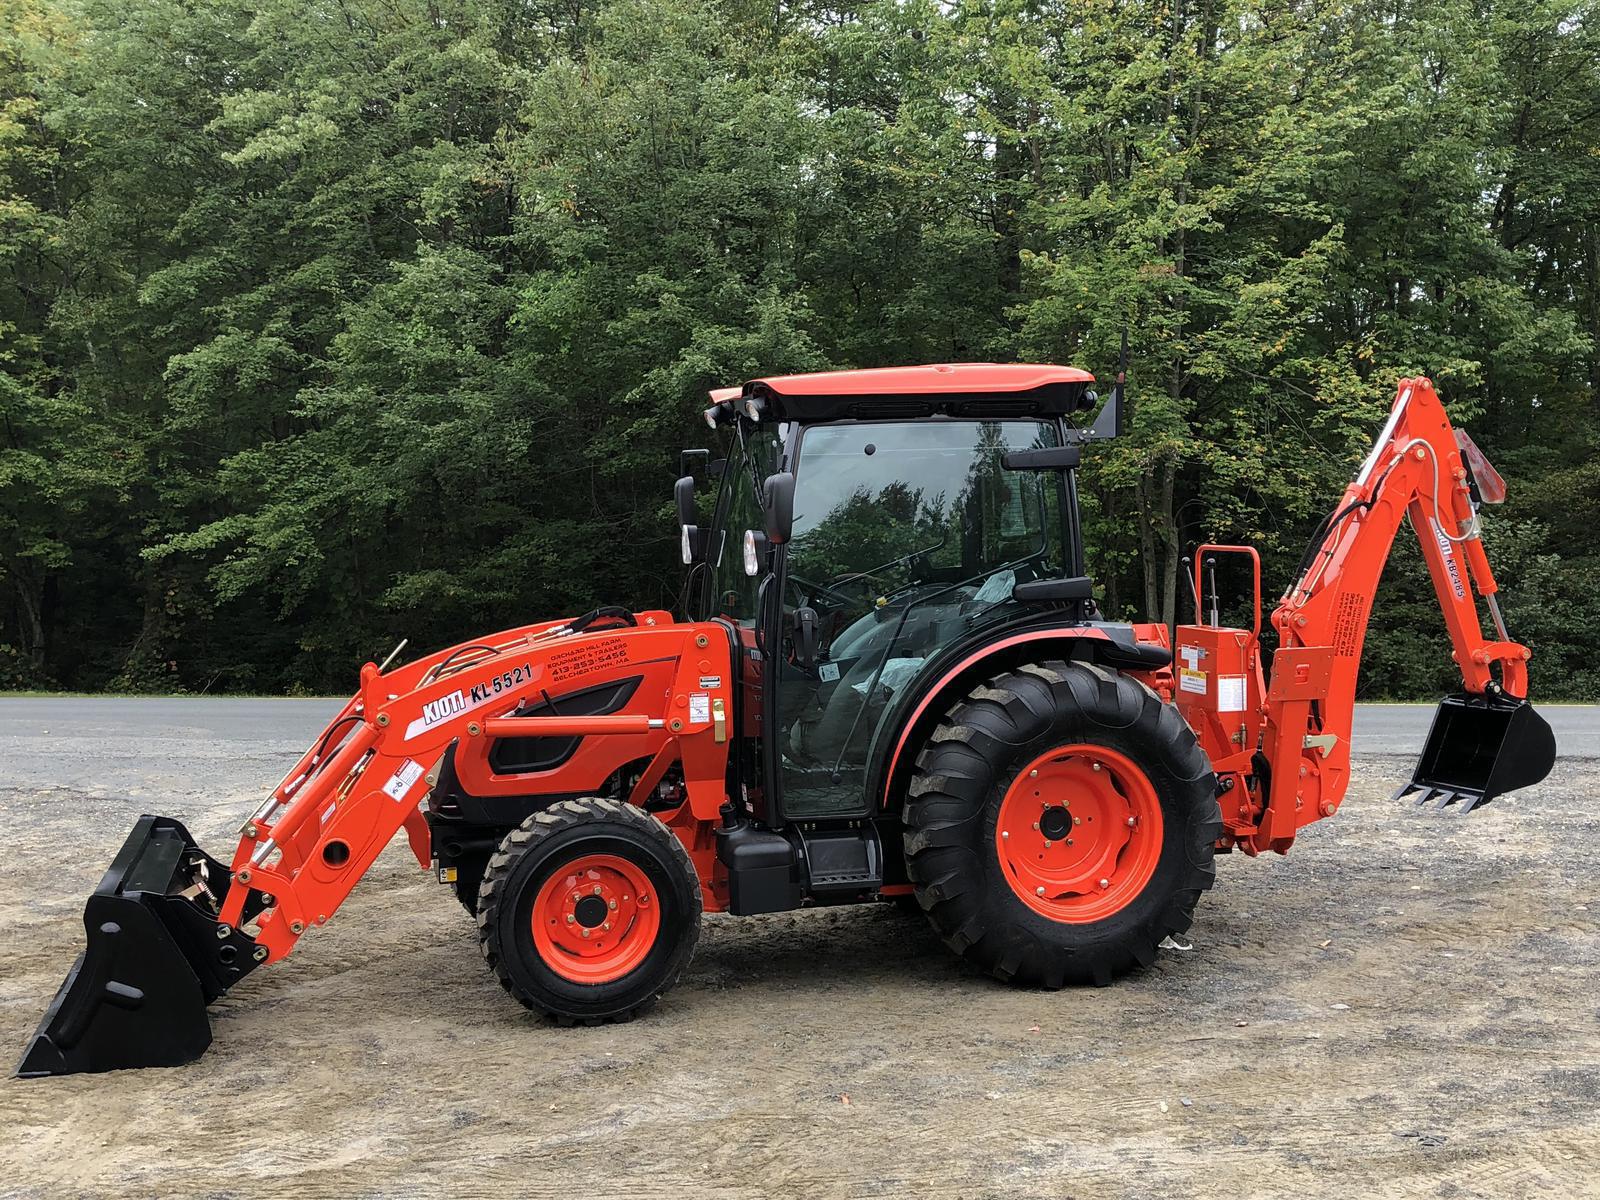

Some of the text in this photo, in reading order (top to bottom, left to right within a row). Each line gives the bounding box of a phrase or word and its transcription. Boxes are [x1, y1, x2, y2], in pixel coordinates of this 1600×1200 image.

[1447, 559, 1465, 597] KB2485
[547, 654, 586, 669] EQUIPMENT
[595, 643, 628, 655] TRAILERS
[551, 638, 622, 660] ORCHARD HILL FARM
[552, 650, 627, 675] 413-253-5456
[422, 689, 466, 725] KIOTI
